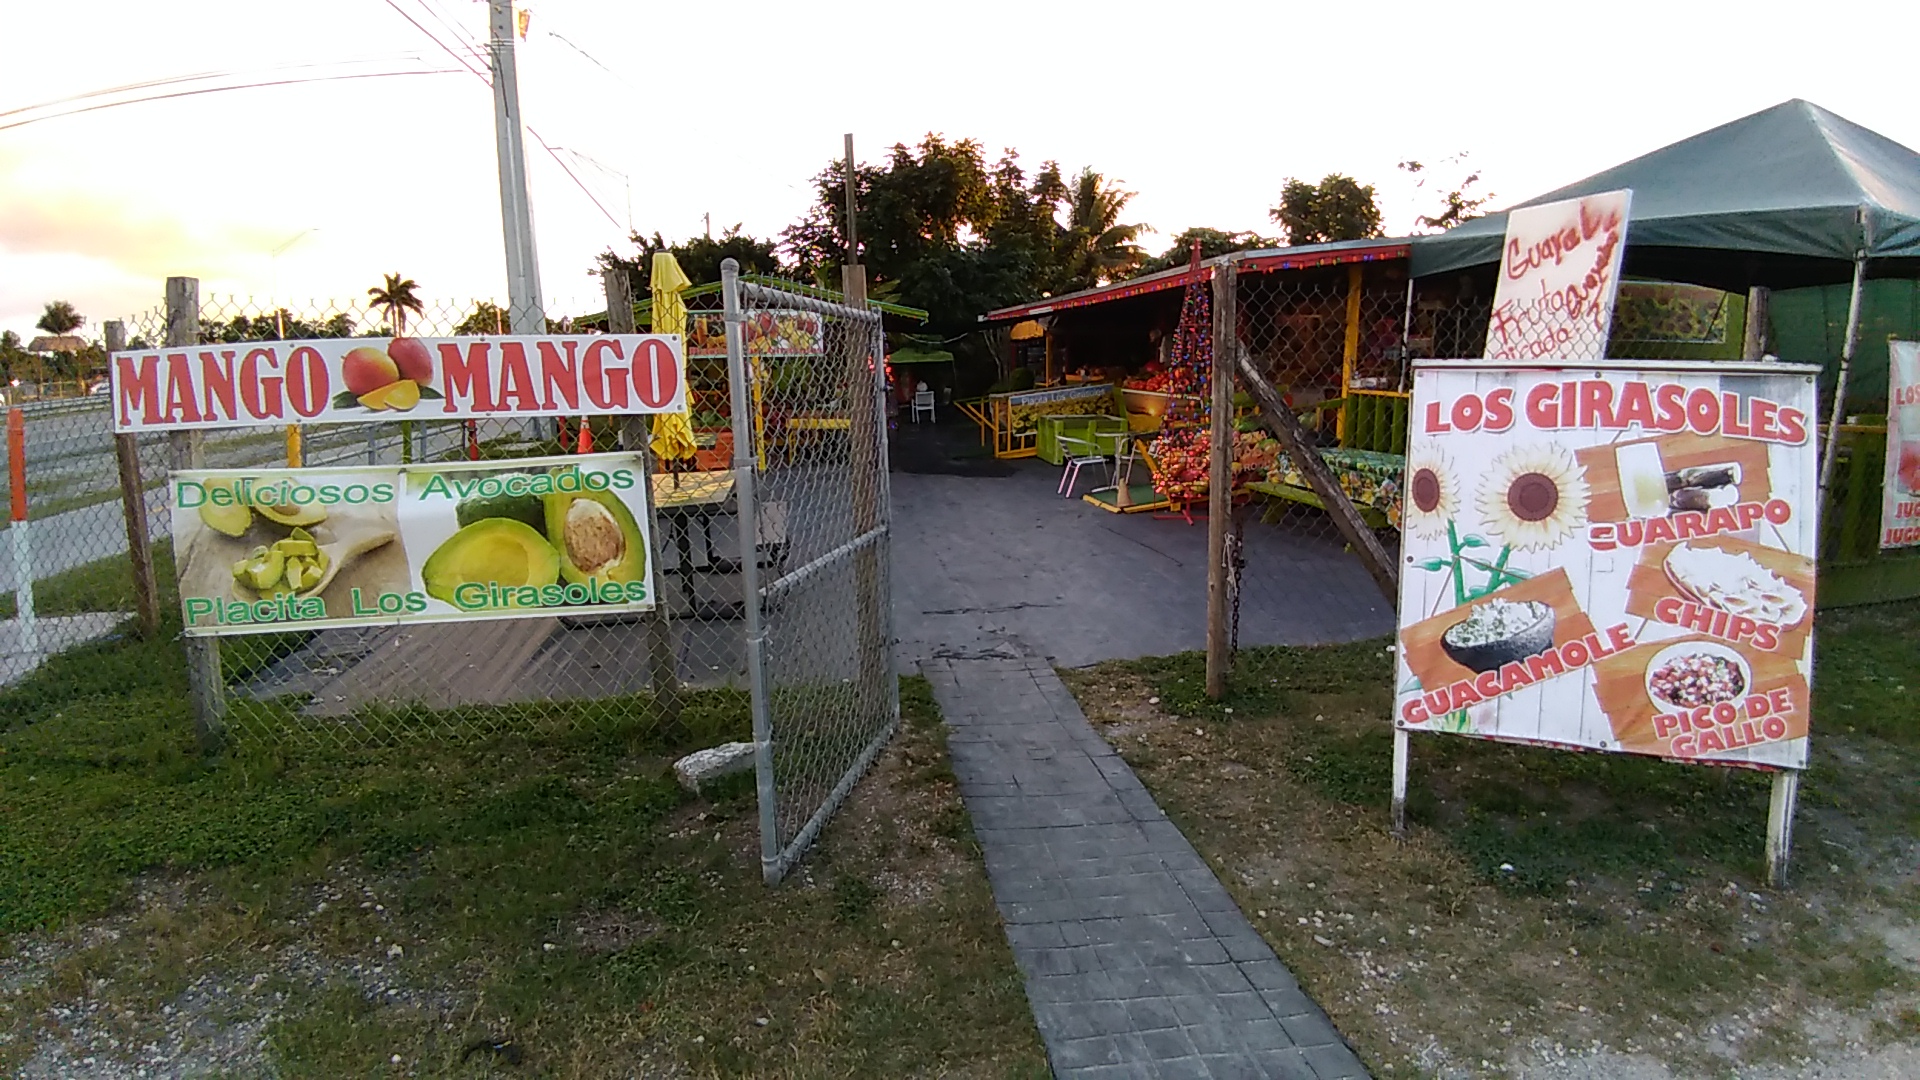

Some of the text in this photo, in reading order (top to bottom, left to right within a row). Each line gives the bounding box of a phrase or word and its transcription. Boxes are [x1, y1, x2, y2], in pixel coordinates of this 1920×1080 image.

[116, 338, 680, 426] MANGO MANGO
[1424, 380, 1809, 444] LOS GIRASOLES
[176, 466, 636, 510] Deliciosos Avocados
[186, 576, 647, 625] Placita Los Girasoles
[1654, 598, 1780, 651] CHIPS
[1402, 623, 1638, 724] GUACAMOLE
[1654, 688, 1792, 739] PICO DE
[1671, 716, 1787, 757] GALLO
